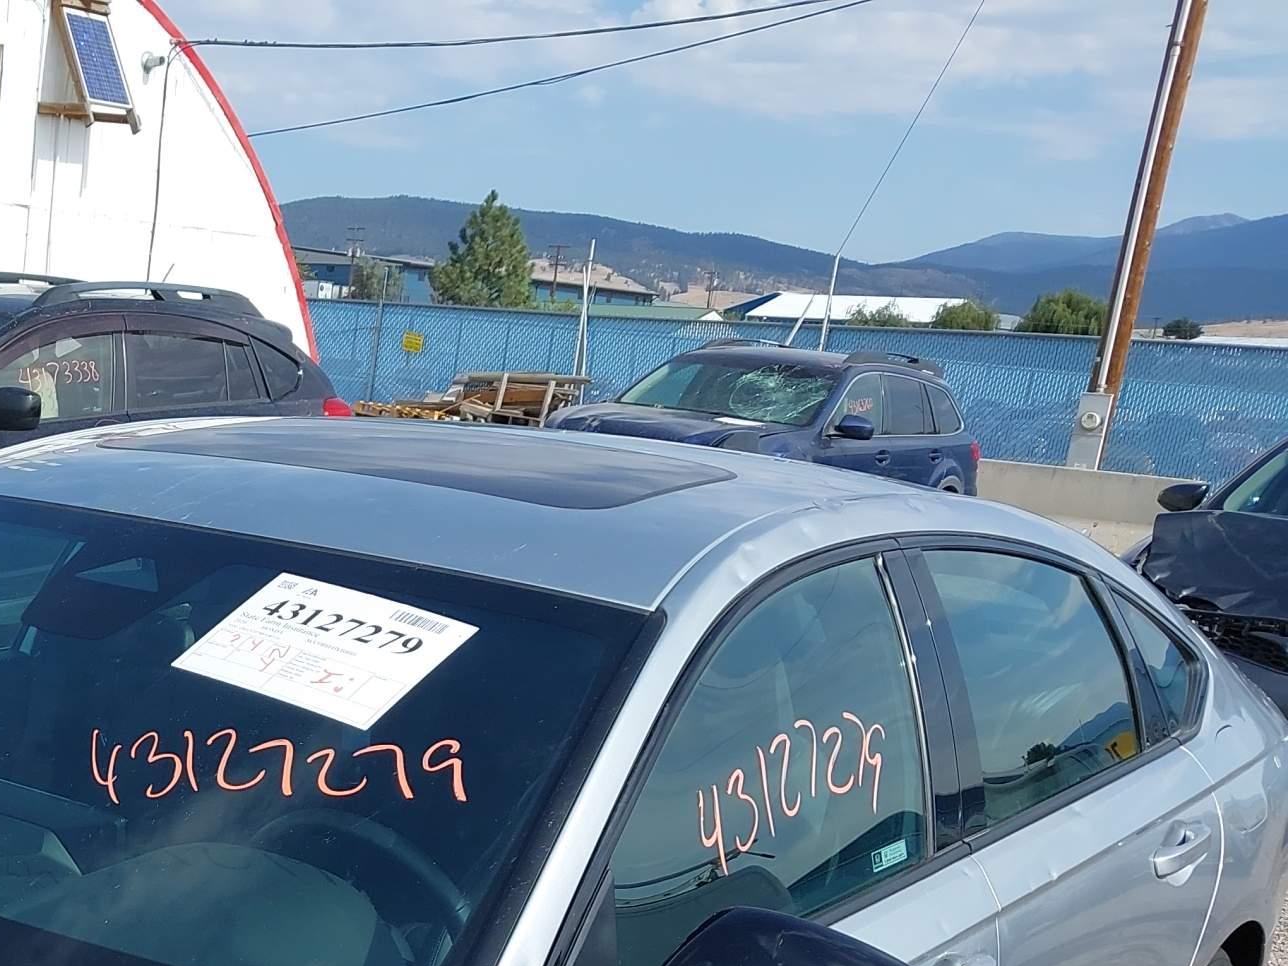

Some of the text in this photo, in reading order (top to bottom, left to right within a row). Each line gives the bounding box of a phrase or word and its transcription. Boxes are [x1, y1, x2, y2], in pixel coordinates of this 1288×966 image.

[18, 360, 100, 392] 43173338
[262, 600, 424, 655] 43127279
[91, 729, 467, 804] 43127279
